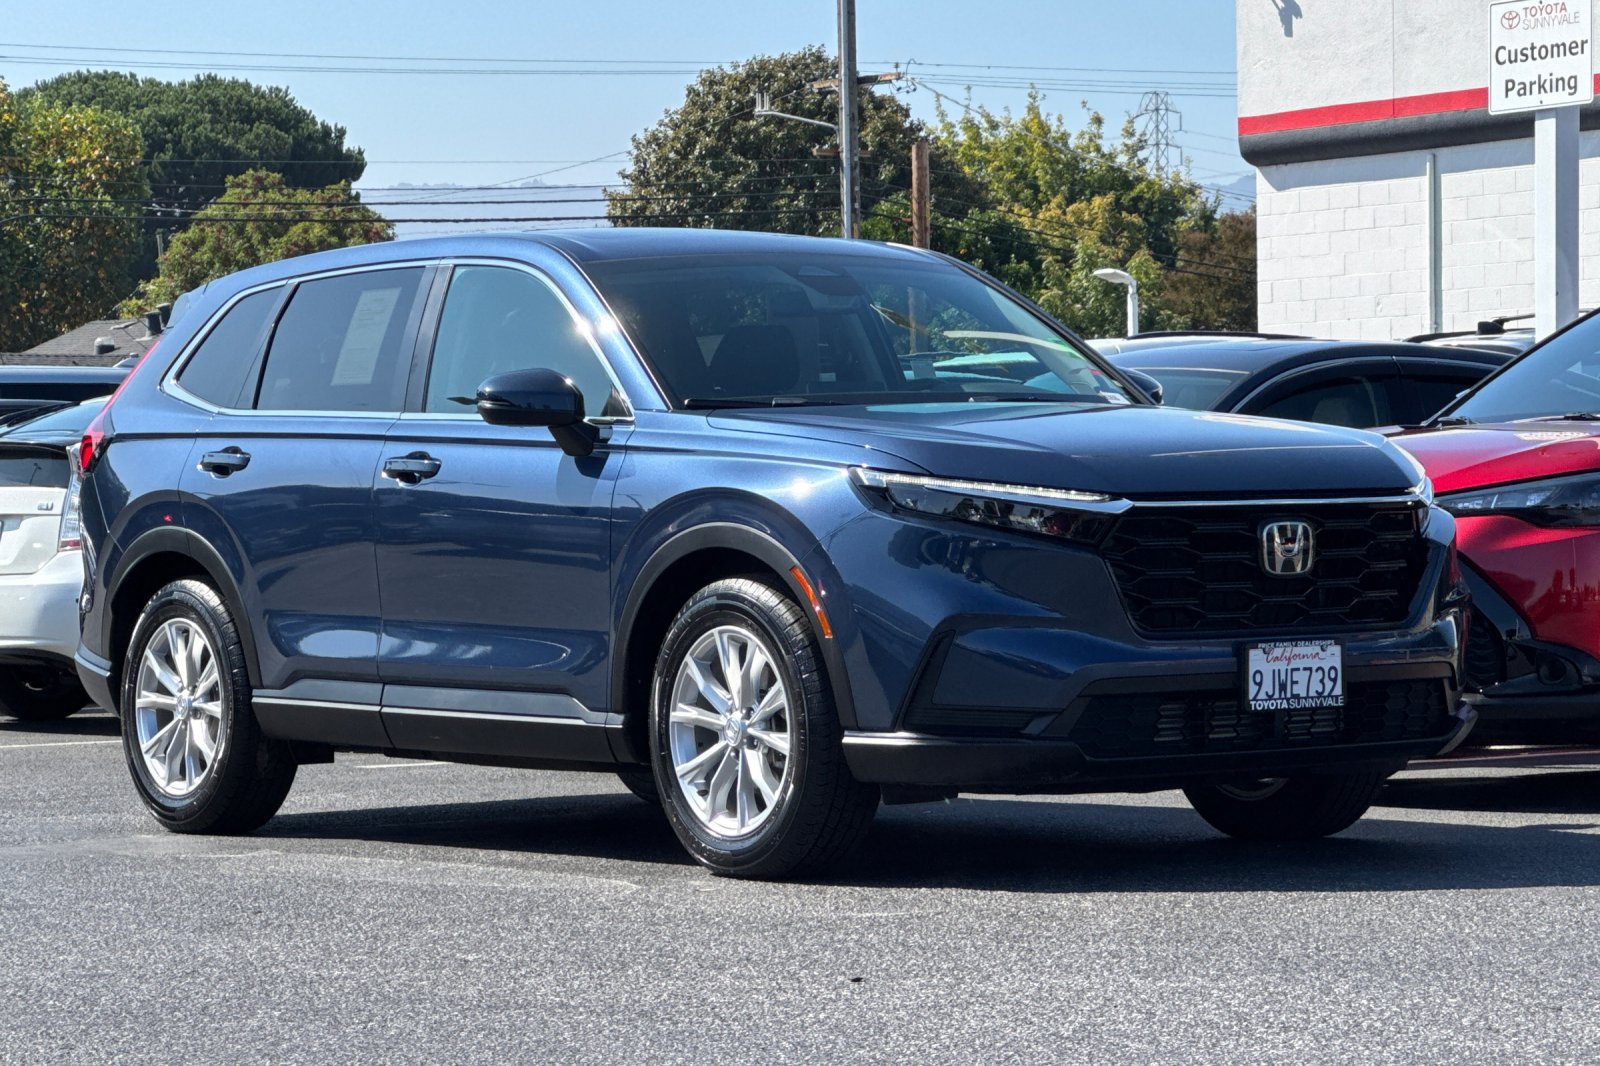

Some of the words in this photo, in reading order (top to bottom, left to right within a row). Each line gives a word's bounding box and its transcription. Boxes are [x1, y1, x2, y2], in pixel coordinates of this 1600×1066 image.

[1523, 2, 1567, 18] TOYOTA
[1522, 12, 1580, 30] SUNNYVALE
[1495, 39, 1588, 65] Customer
[1505, 72, 1577, 98] Parking
[1265, 646, 1327, 666] California
[1252, 665, 1338, 700] 9JWE739
[1250, 699, 1288, 711] TOYOTA
[1289, 696, 1344, 709] SUNNYVALE
